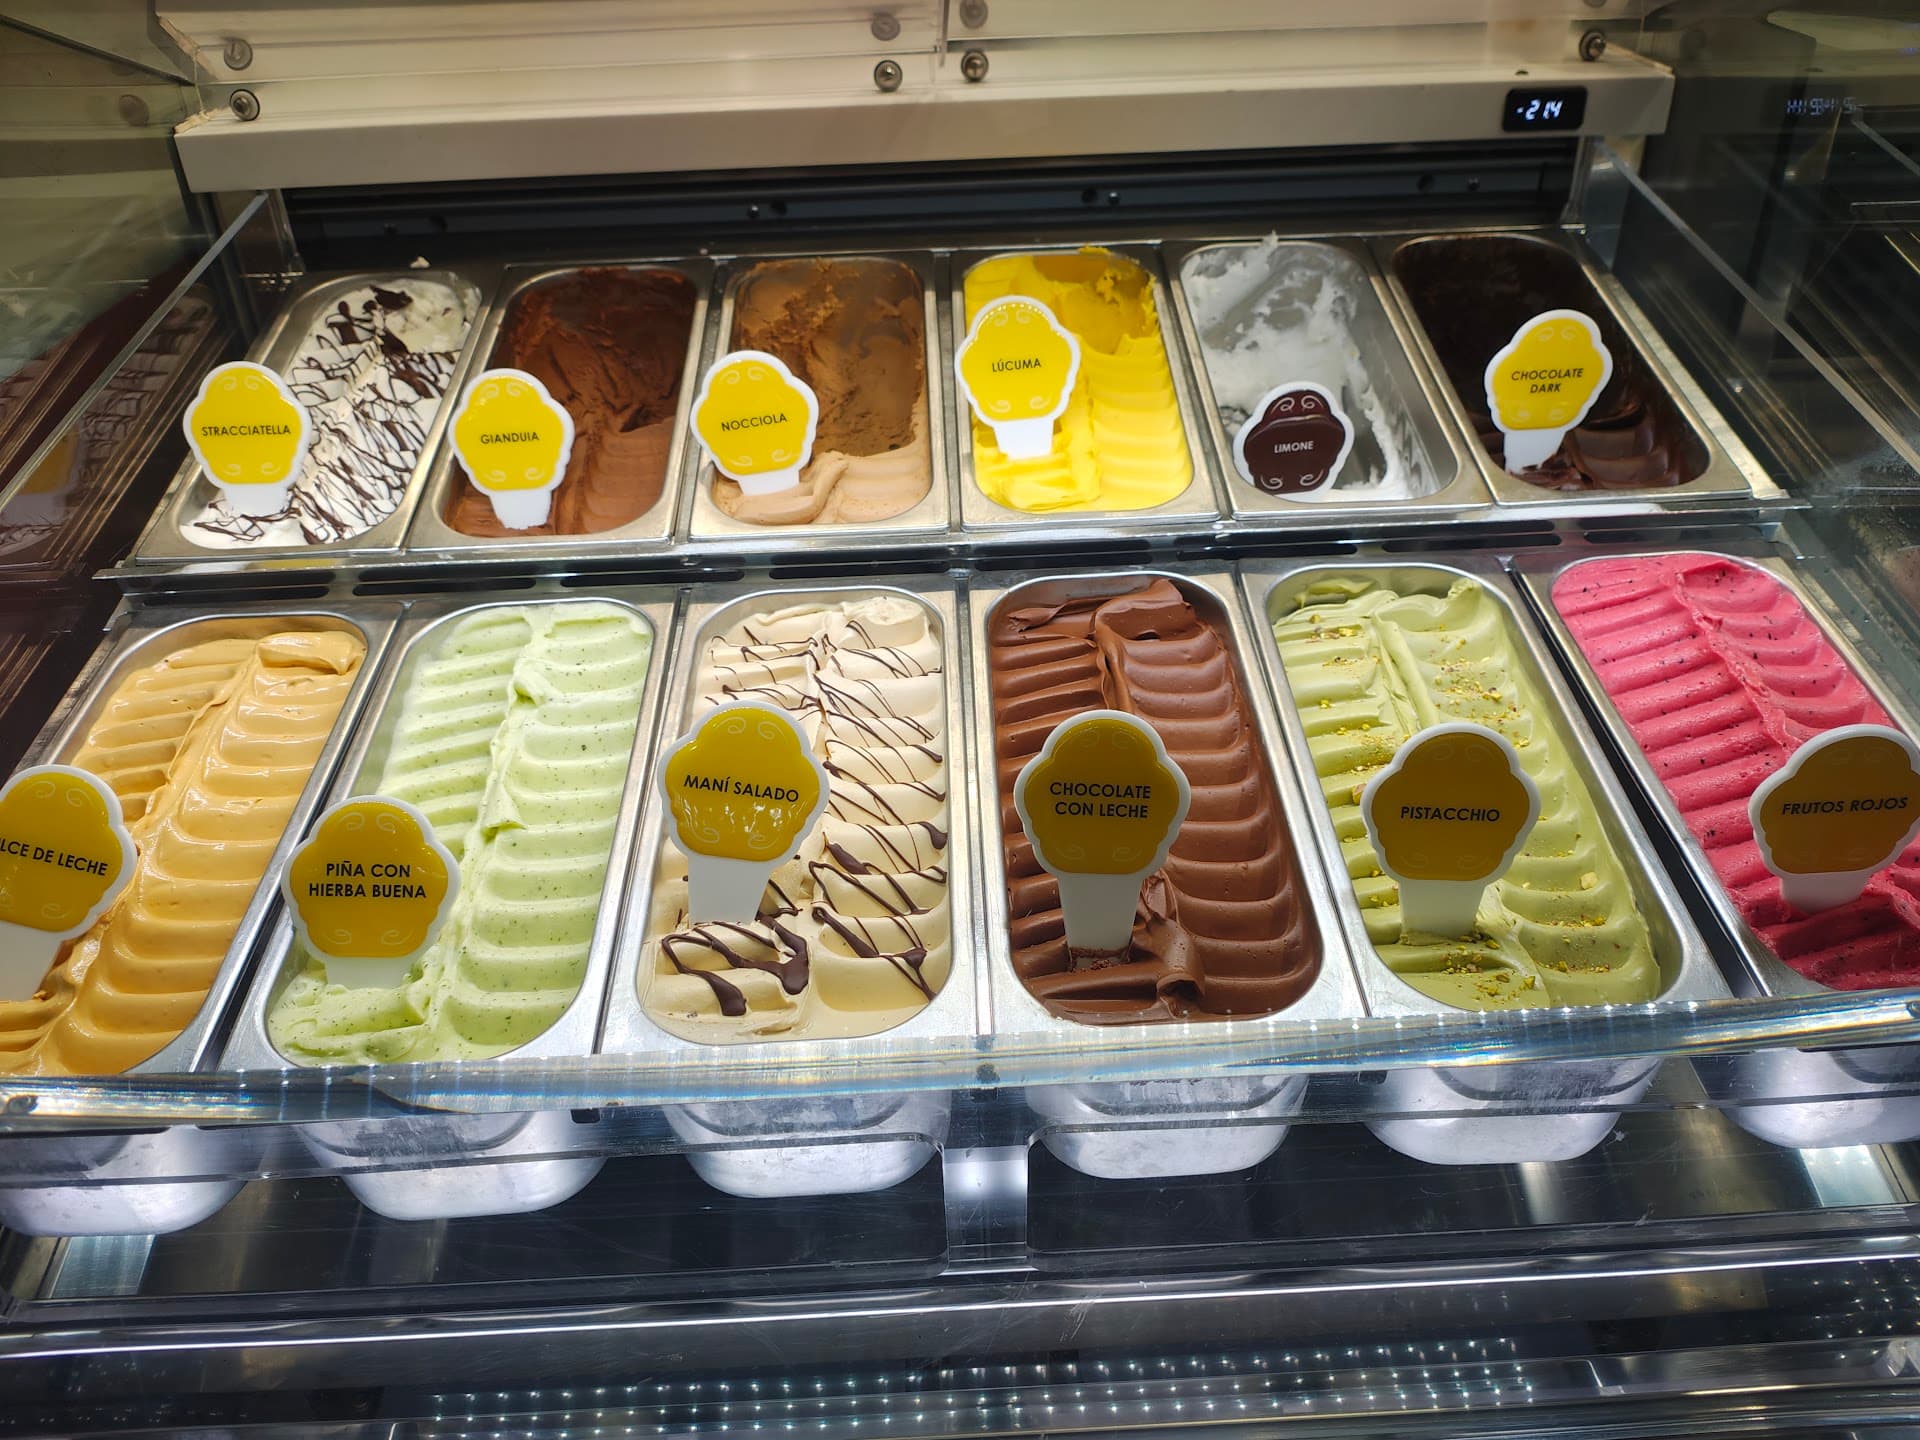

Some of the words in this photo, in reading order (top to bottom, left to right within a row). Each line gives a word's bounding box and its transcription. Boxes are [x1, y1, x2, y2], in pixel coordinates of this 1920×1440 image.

[991, 357, 1041, 373] LÚCUMA
[1511, 367, 1584, 381] CHOCOLATE
[1529, 383, 1562, 394] DARK
[721, 413, 787, 432] NOCCIOLA
[201, 425, 291, 437] STRACCIATELLA
[480, 431, 540, 444] GIANDUIA
[1273, 440, 1314, 454] LIMONE
[684, 775, 731, 793] MANÍ
[733, 781, 799, 802] SALADO
[1050, 782, 1152, 799] CHOCOLATE
[1055, 801, 1094, 816] CON
[1099, 804, 1149, 818] LECHE
[1782, 801, 1845, 815] FRUTOS
[1850, 796, 1909, 812] ROJOS
[1400, 806, 1500, 822] PISTACCHIO
[0, 838, 29, 857] LCE
[32, 847, 56, 863] DE
[57, 853, 108, 876] LECHE
[326, 860, 365, 877] PIÑA
[371, 864, 411, 878] CON
[309, 883, 366, 897] HIERBA
[372, 885, 427, 898] BUENA
